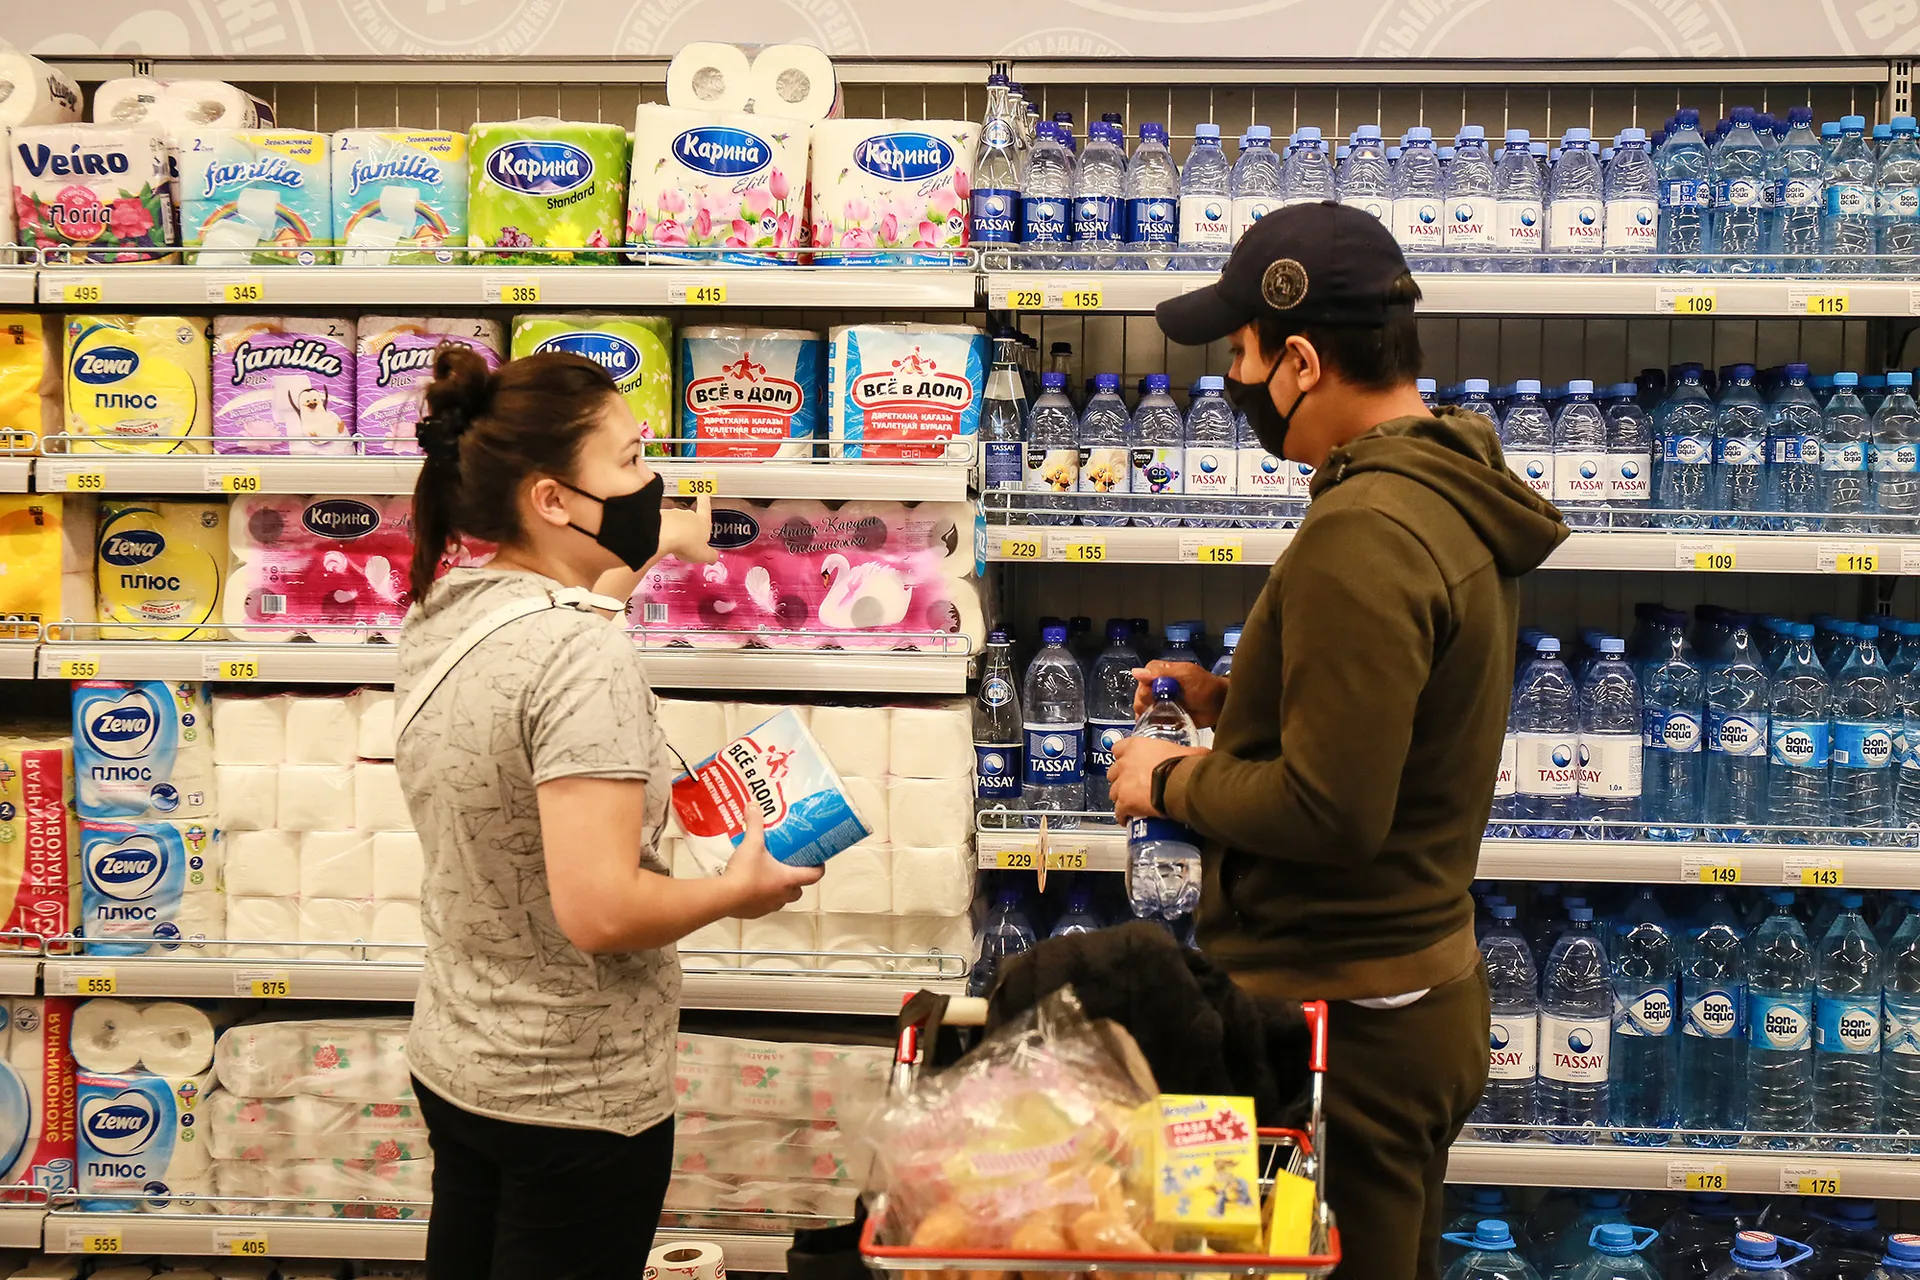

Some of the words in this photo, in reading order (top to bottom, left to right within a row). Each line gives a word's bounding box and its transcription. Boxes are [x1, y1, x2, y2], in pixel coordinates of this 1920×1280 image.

[193, 139, 201, 151] 2
[341, 138, 348, 150] 2
[684, 133, 759, 165] Карина
[865, 141, 942, 170] Карина
[499, 150, 579, 182] Карина
[203, 157, 303, 196] familia
[350, 155, 441, 194] familia
[547, 181, 595, 209] Standard
[49, 204, 112, 228] floria
[974, 219, 1015, 232] TASSAY
[1027, 223, 1064, 234] TASSAY
[1075, 222, 1108, 233] TASSAY
[1137, 223, 1174, 234] TASSAY
[1195, 223, 1229, 233] TASSAY
[1409, 225, 1442, 236] TASSAY
[1448, 223, 1483, 234] TASSAY
[75, 288, 98, 299] 495
[233, 287, 257, 300] 345
[513, 288, 536, 301] 385
[697, 288, 720, 301] 415
[1017, 293, 1041, 306] 229
[1075, 293, 1098, 306] 155
[1688, 297, 1712, 312] 109
[1818, 299, 1843, 312] 115
[327, 325, 335, 336] 2
[473, 325, 481, 337] 2
[80, 355, 133, 375] Zewa
[234, 341, 341, 383] familia
[245, 375, 267, 387] Plus
[390, 375, 412, 388] Plus
[696, 383, 729, 403] ВСЁ
[748, 386, 792, 404] ДОМ
[864, 378, 898, 398] ВСЁ
[916, 382, 963, 400] ДОМ
[96, 393, 157, 409] ПЛЮС
[705, 426, 748, 434] ТУАЛЕТНАЯ
[752, 427, 782, 435] БУМАГА
[871, 421, 917, 431] ТУАЛЕТНАЯ
[920, 422, 952, 431] БУМАГА
[78, 475, 101, 488] 555
[233, 477, 256, 490] 649
[1191, 475, 1227, 485] TASSAY
[1251, 475, 1286, 485] TASSAY
[1292, 476, 1312, 487] TASS
[1523, 481, 1549, 490] ASSAY
[1569, 481, 1604, 490] TASSAY
[1611, 481, 1647, 490] TASSAY
[689, 480, 713, 494] 385
[311, 507, 370, 528] Карина
[108, 538, 158, 557] Zewa
[785, 537, 867, 555] Белоснежка
[1012, 543, 1036, 557] 229
[1078, 546, 1101, 559] 155
[1210, 548, 1233, 561] 155
[1708, 555, 1732, 569] 109
[1848, 556, 1872, 570] 115
[121, 574, 180, 590] ПЛЮС
[141, 604, 181, 614] МЯГКОСТИ
[71, 664, 94, 677] 555
[230, 664, 253, 677] 875
[99, 715, 147, 733] Zewa
[1664, 730, 1691, 741] aqua
[1720, 733, 1748, 744] aqua
[1785, 744, 1813, 755] aqua
[1863, 746, 1888, 756] aqua
[1031, 759, 1077, 772] TASSAY
[92, 767, 152, 781] ПЛЮС
[728, 744, 757, 770] ВСЁ
[750, 779, 777, 817] ДОМ
[1579, 769, 1602, 783] SSAY
[717, 804, 734, 831] БУМАГА
[26, 759, 46, 895] ЭКОНОМИЧНАЯ
[45, 801, 62, 895] УПАКОВКА
[102, 857, 151, 875] Zewa
[193, 858, 200, 867] 2
[1007, 854, 1031, 867] 229
[1060, 855, 1082, 868] 175
[1712, 868, 1736, 882] 149
[1813, 871, 1837, 884] 143
[98, 906, 157, 920] ПЛЮС
[32, 918, 56, 935] 12
[88, 979, 111, 992] 555
[263, 982, 285, 994] 875
[1644, 1009, 1671, 1021] aqua
[1703, 1011, 1734, 1023] aqua
[1766, 1023, 1797, 1035] aqua
[1840, 1027, 1871, 1039] aqua
[1490, 1052, 1523, 1066] SSAY
[1553, 1053, 1603, 1069] TASSAY
[46, 1013, 60, 1142] ЭКОНОМИЧНАЯ
[62, 1054, 74, 1142] УПАКОВКА
[95, 1112, 142, 1130] Zewa
[88, 1162, 146, 1178] ПЛЮС
[43, 1175, 65, 1190] 12
[1698, 1175, 1722, 1188] 178
[1811, 1180, 1835, 1193] 175
[94, 1239, 117, 1250] 555
[242, 1241, 265, 1254] 405
